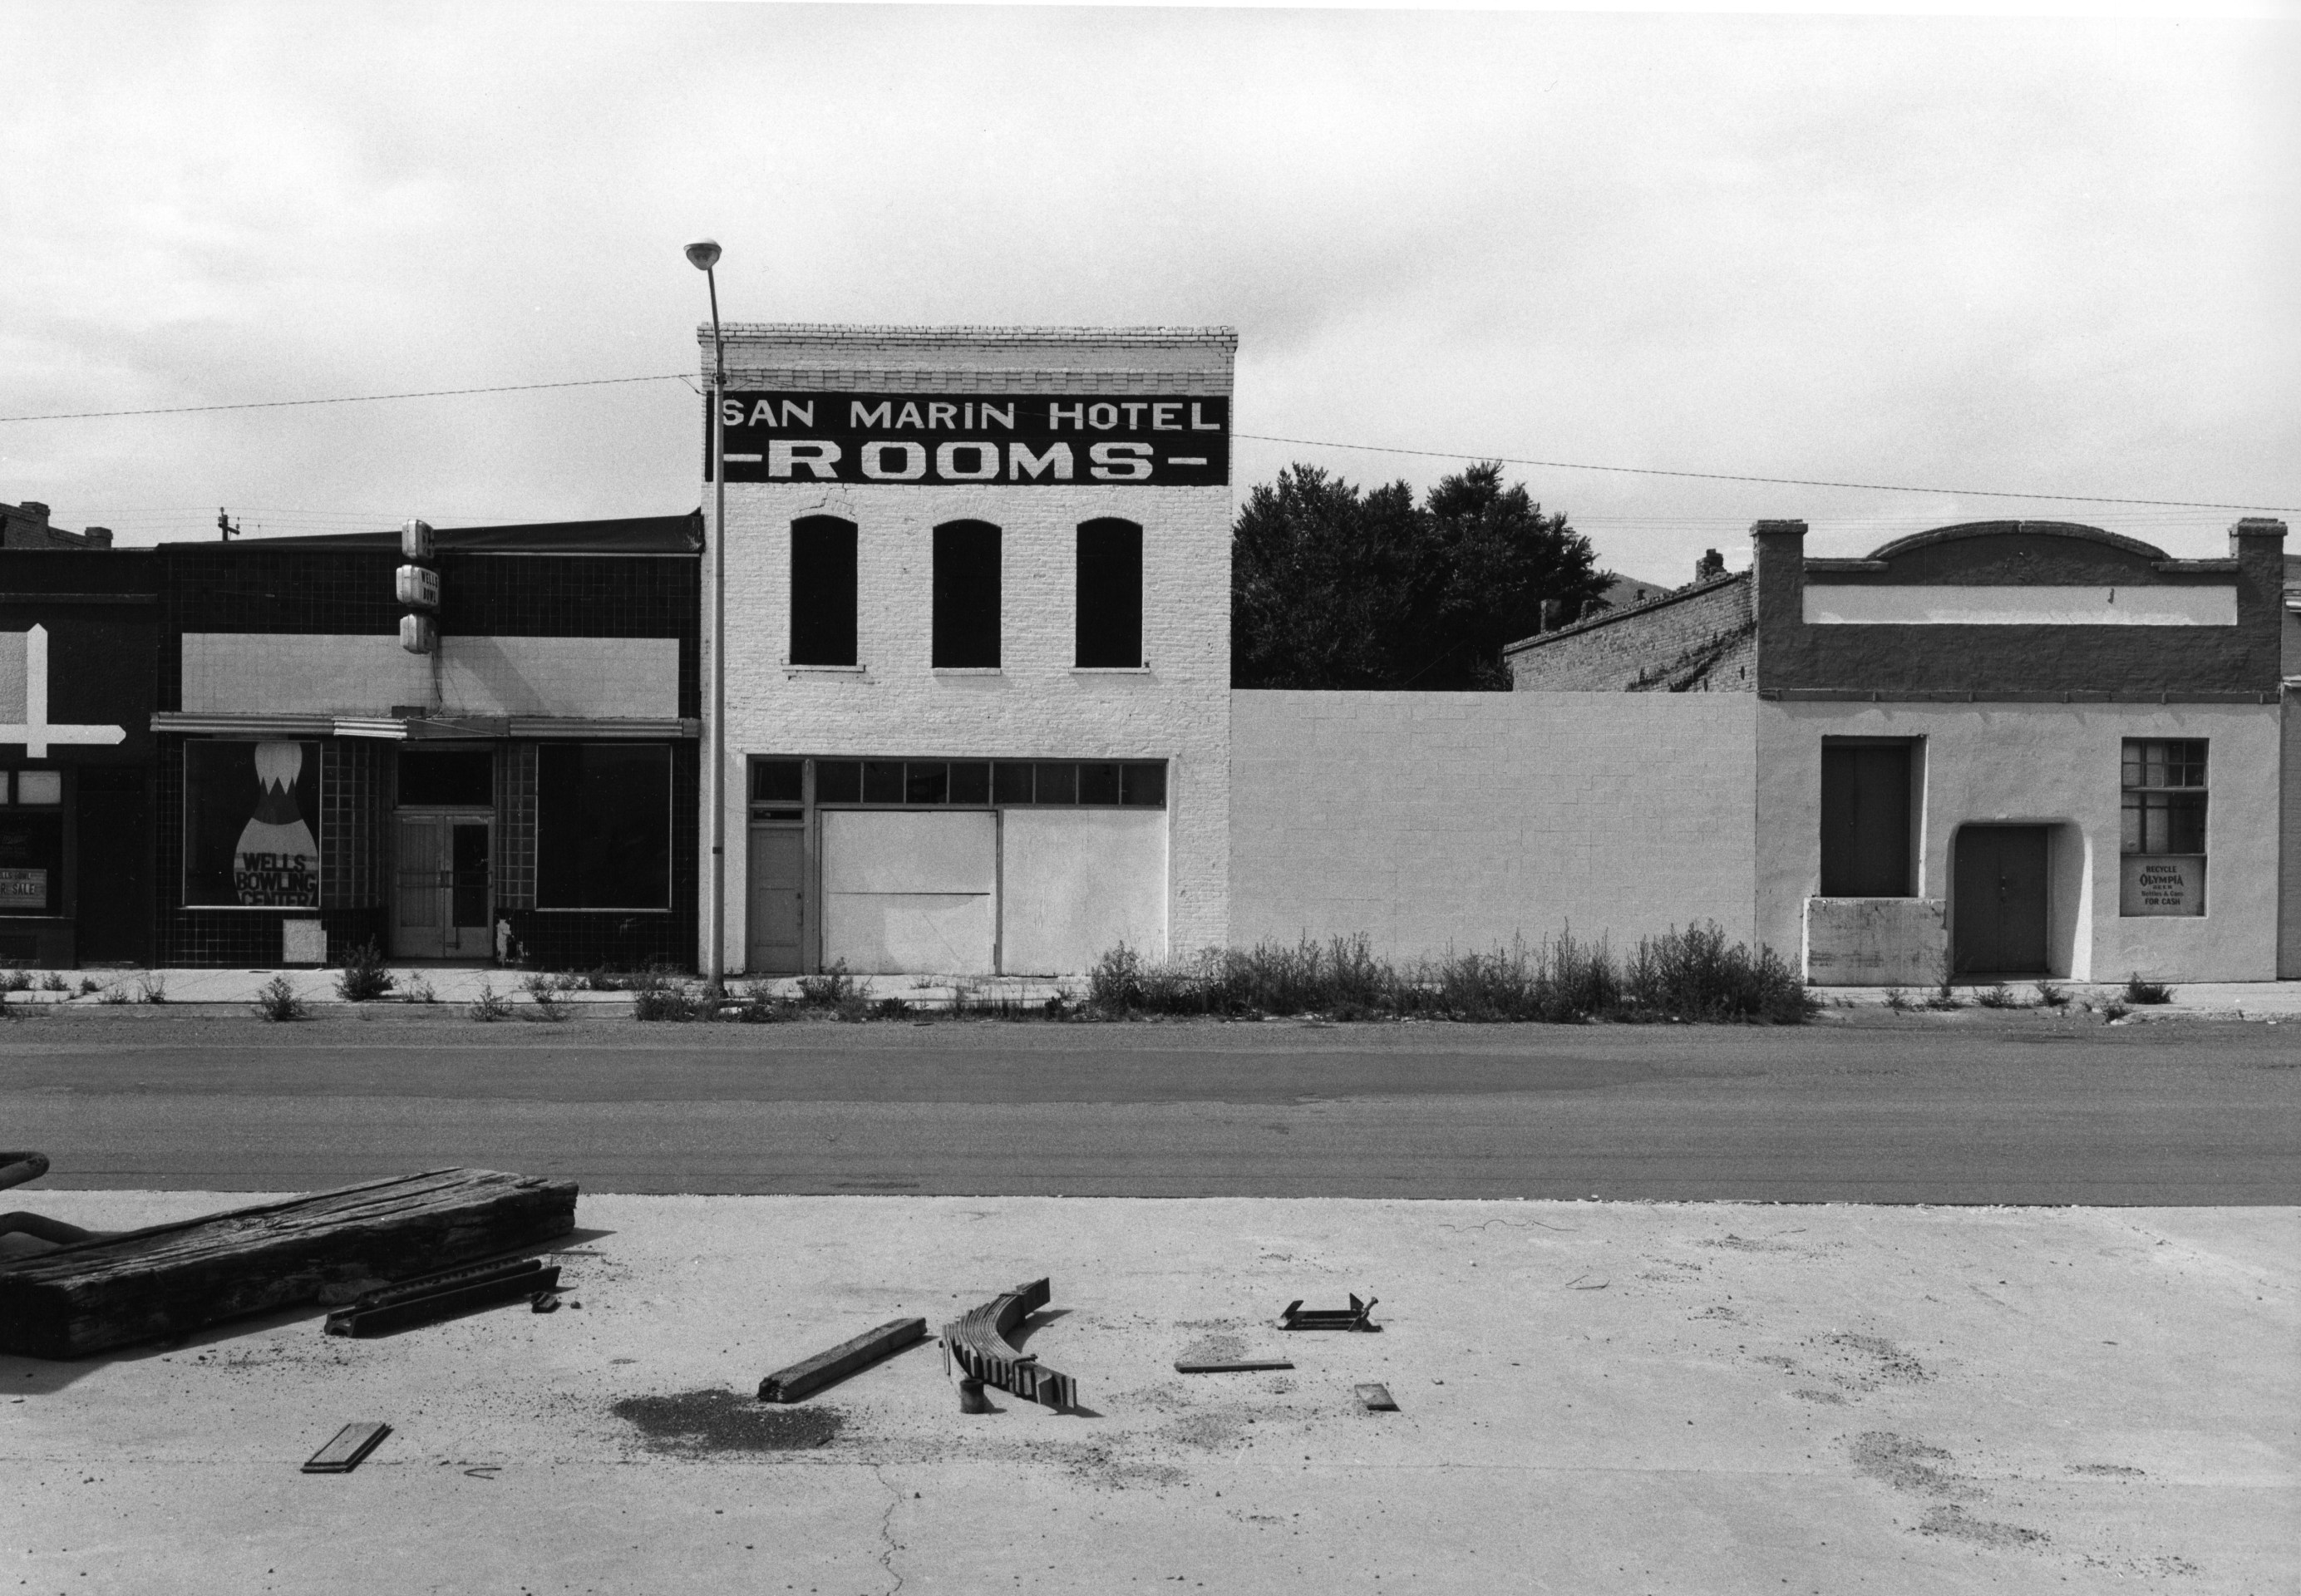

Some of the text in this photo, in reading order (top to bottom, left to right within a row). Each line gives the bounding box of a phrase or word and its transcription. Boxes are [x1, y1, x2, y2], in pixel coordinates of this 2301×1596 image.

[723, 399, 1220, 431] SAN MARIN HOTEL
[421, 571, 438, 588] WELLS
[423, 588, 436, 603] BOWL
[243, 852, 306, 872] WELLS
[15, 871, 31, 879] BOWL
[236, 872, 316, 892] BOWLING
[2140, 874, 2184, 886] OLYMPIA
[12, 883, 35, 895] SALE
[241, 891, 309, 906] CENTER
